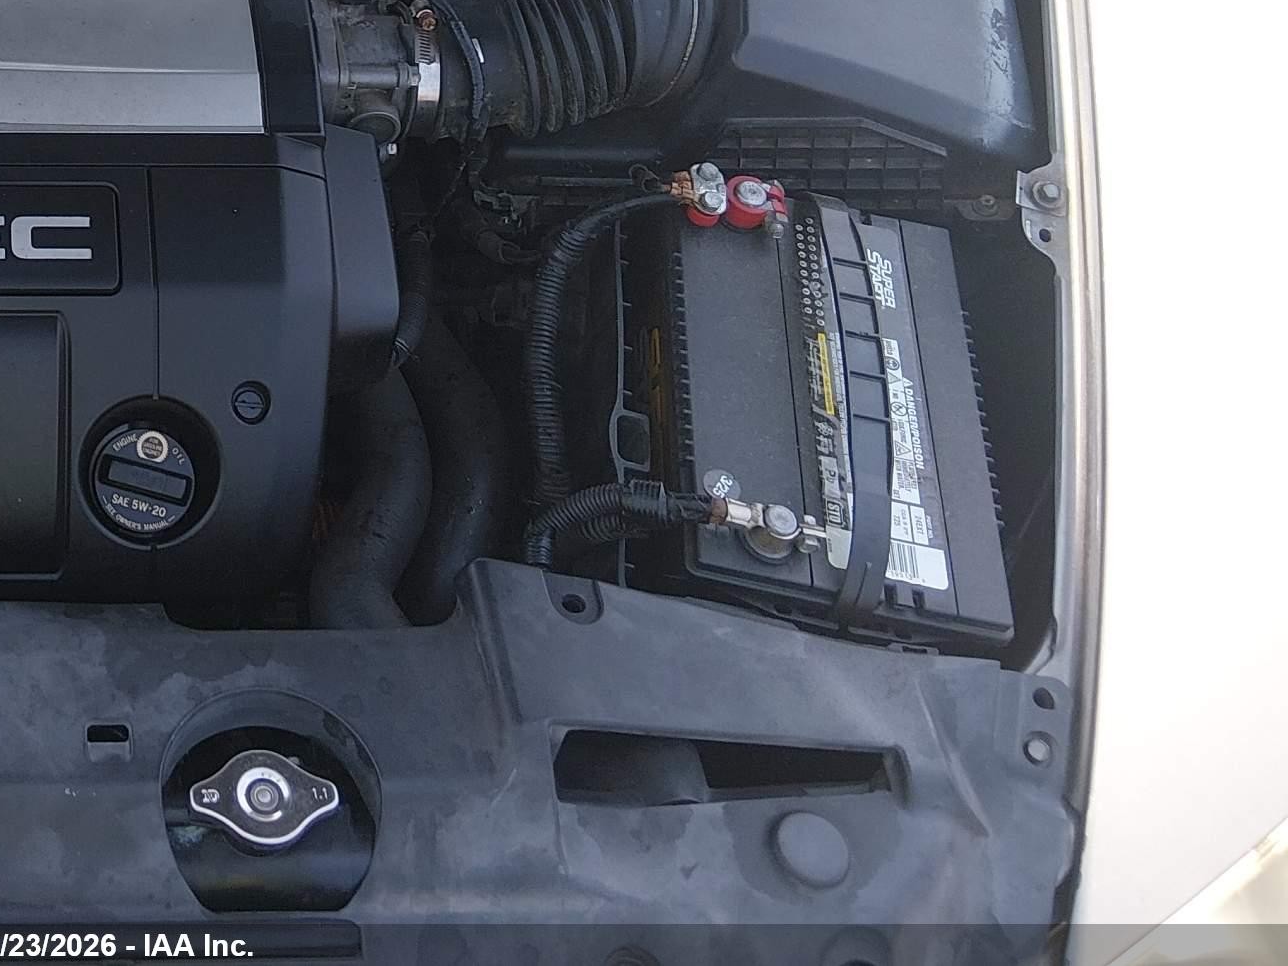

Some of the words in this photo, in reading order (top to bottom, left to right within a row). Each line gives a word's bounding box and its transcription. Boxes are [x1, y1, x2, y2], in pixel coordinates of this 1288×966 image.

[866, 248, 886, 307] START
[880, 257, 897, 309] SUPER
[905, 387, 925, 470] DANGER/POISON
[172, 447, 185, 466] OIL
[712, 475, 733, 499] 3/25
[112, 493, 130, 508] SAE
[143, 519, 169, 531] MANUAL
[312, 787, 329, 801] 1.1
